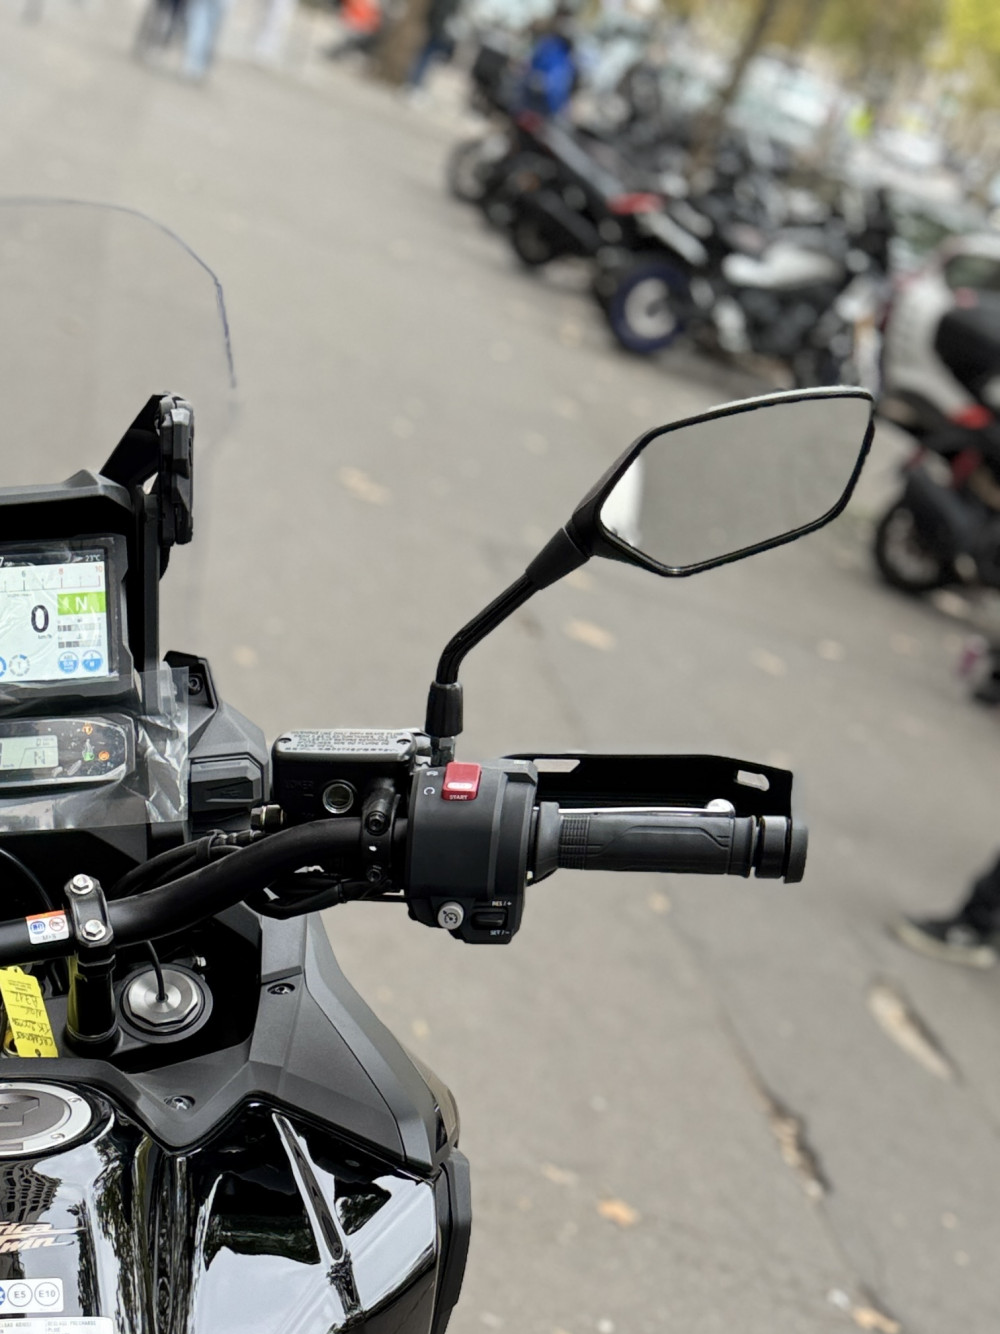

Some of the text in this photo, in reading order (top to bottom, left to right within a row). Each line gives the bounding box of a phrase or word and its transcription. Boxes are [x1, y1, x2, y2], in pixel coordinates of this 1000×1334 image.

[75, 595, 88, 611] N
[31, 604, 50, 633] 0
[13, 1290, 26, 1299] E5
[38, 1289, 56, 1298] E10
